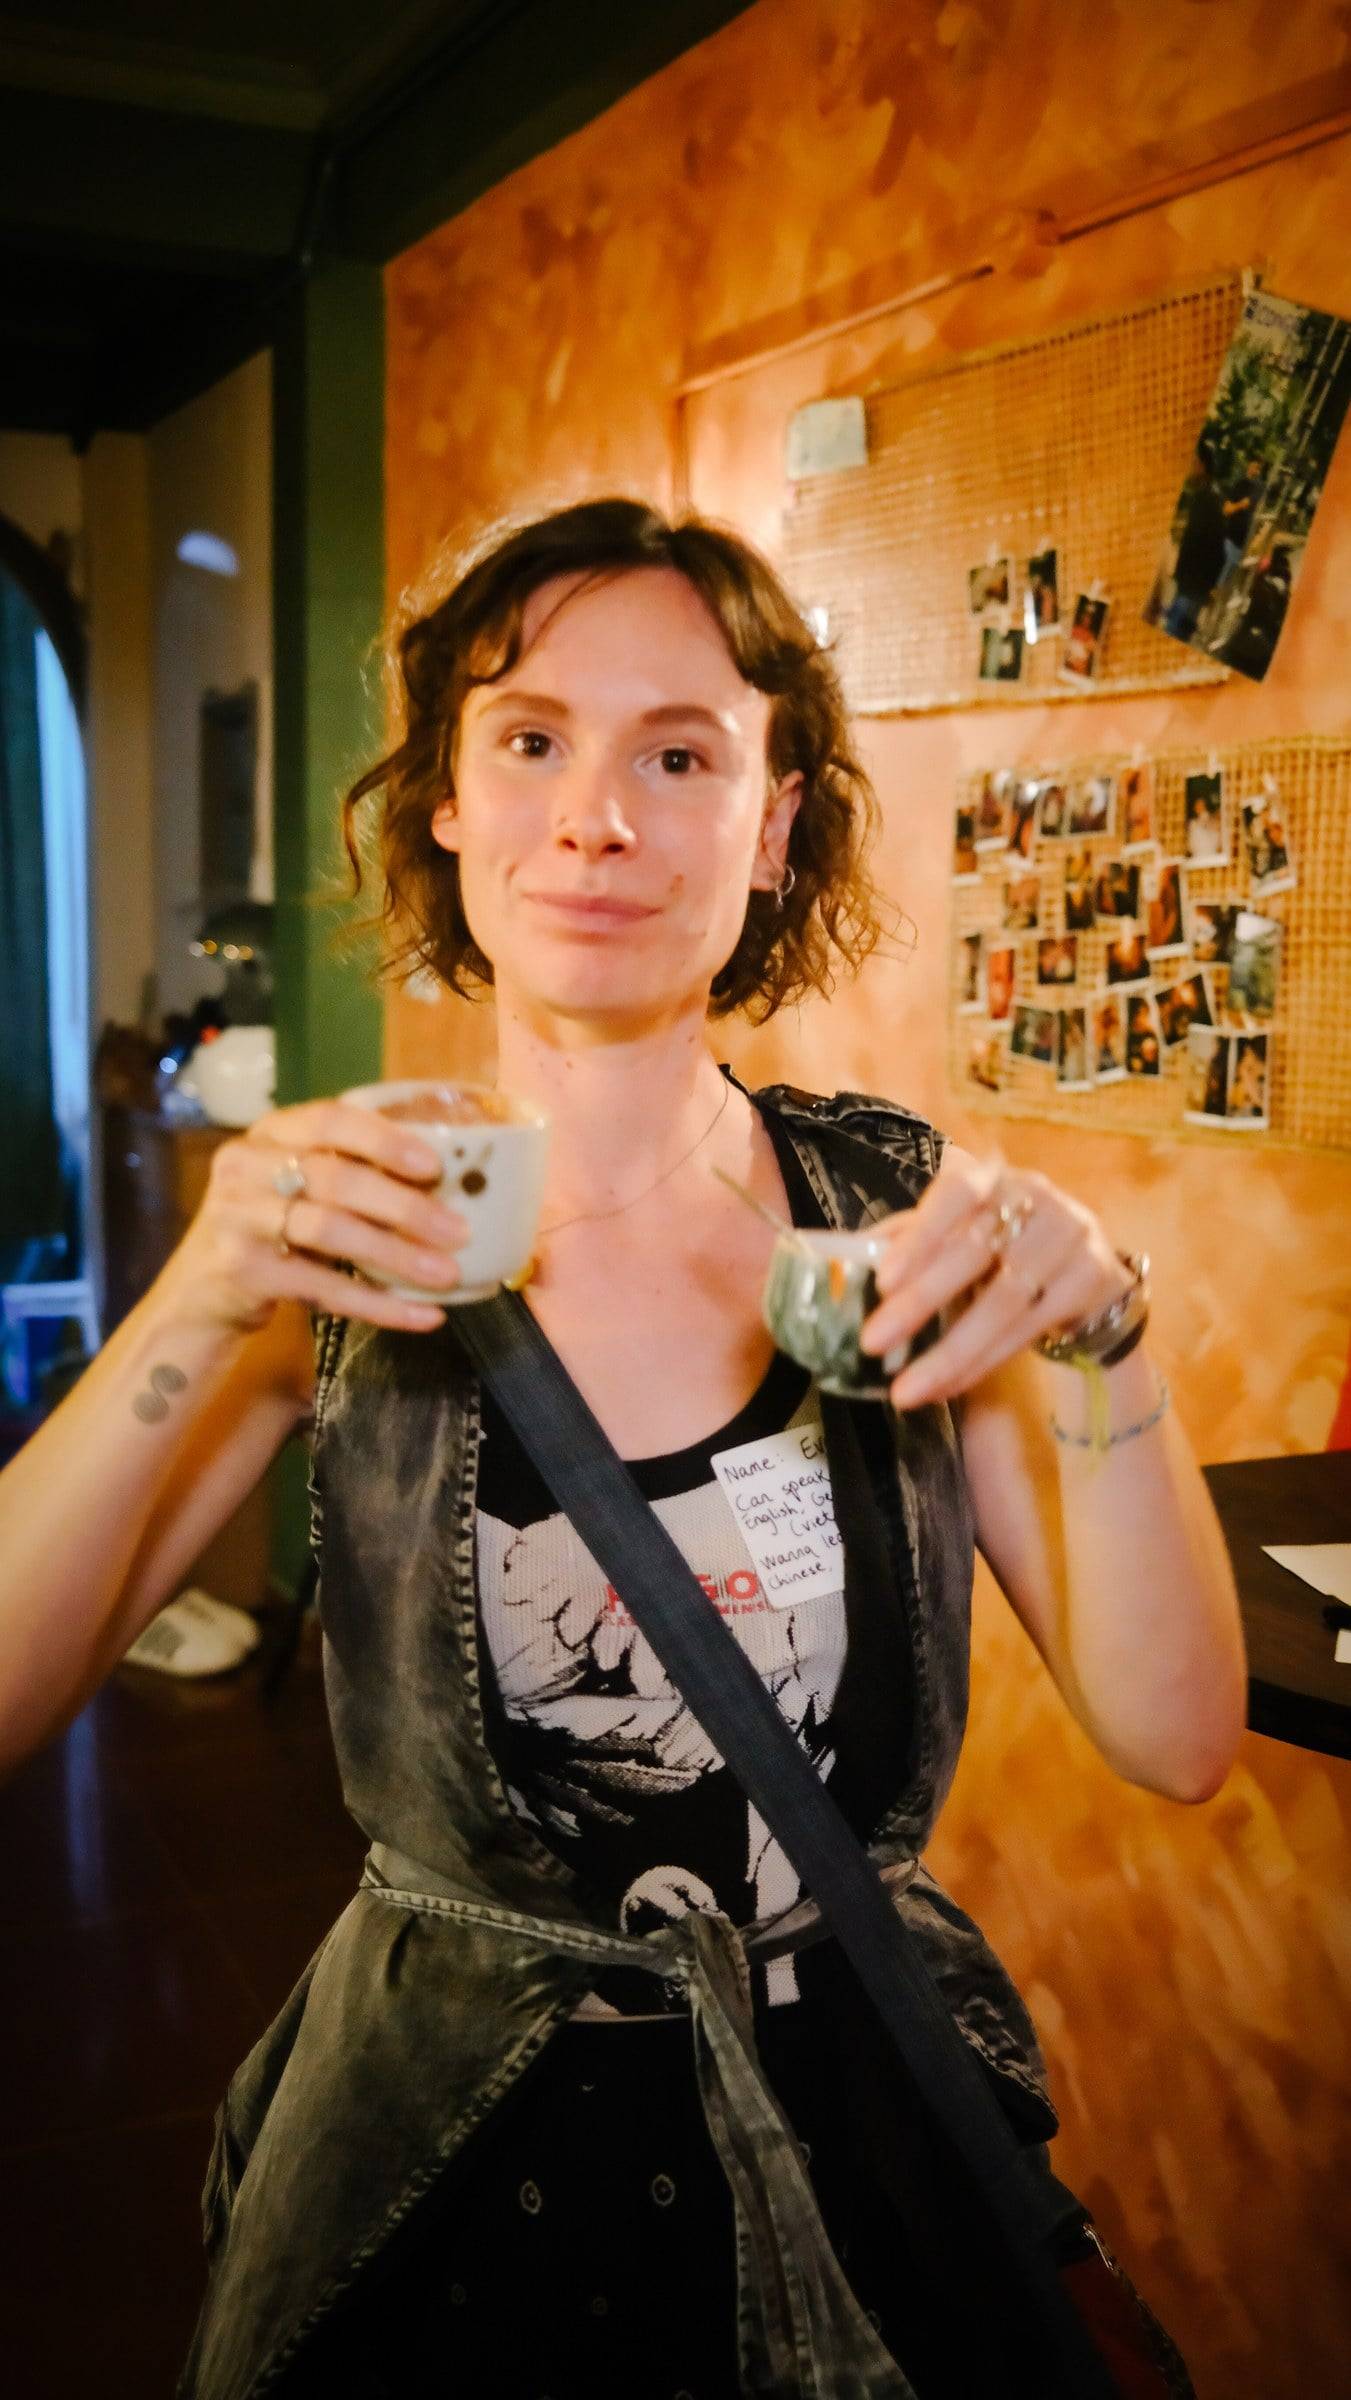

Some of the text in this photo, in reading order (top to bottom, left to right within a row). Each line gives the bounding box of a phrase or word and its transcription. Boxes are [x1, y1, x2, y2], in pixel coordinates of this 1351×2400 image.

[736, 1468, 832, 1511] Can speak
[760, 1545, 820, 1570] Wanna
